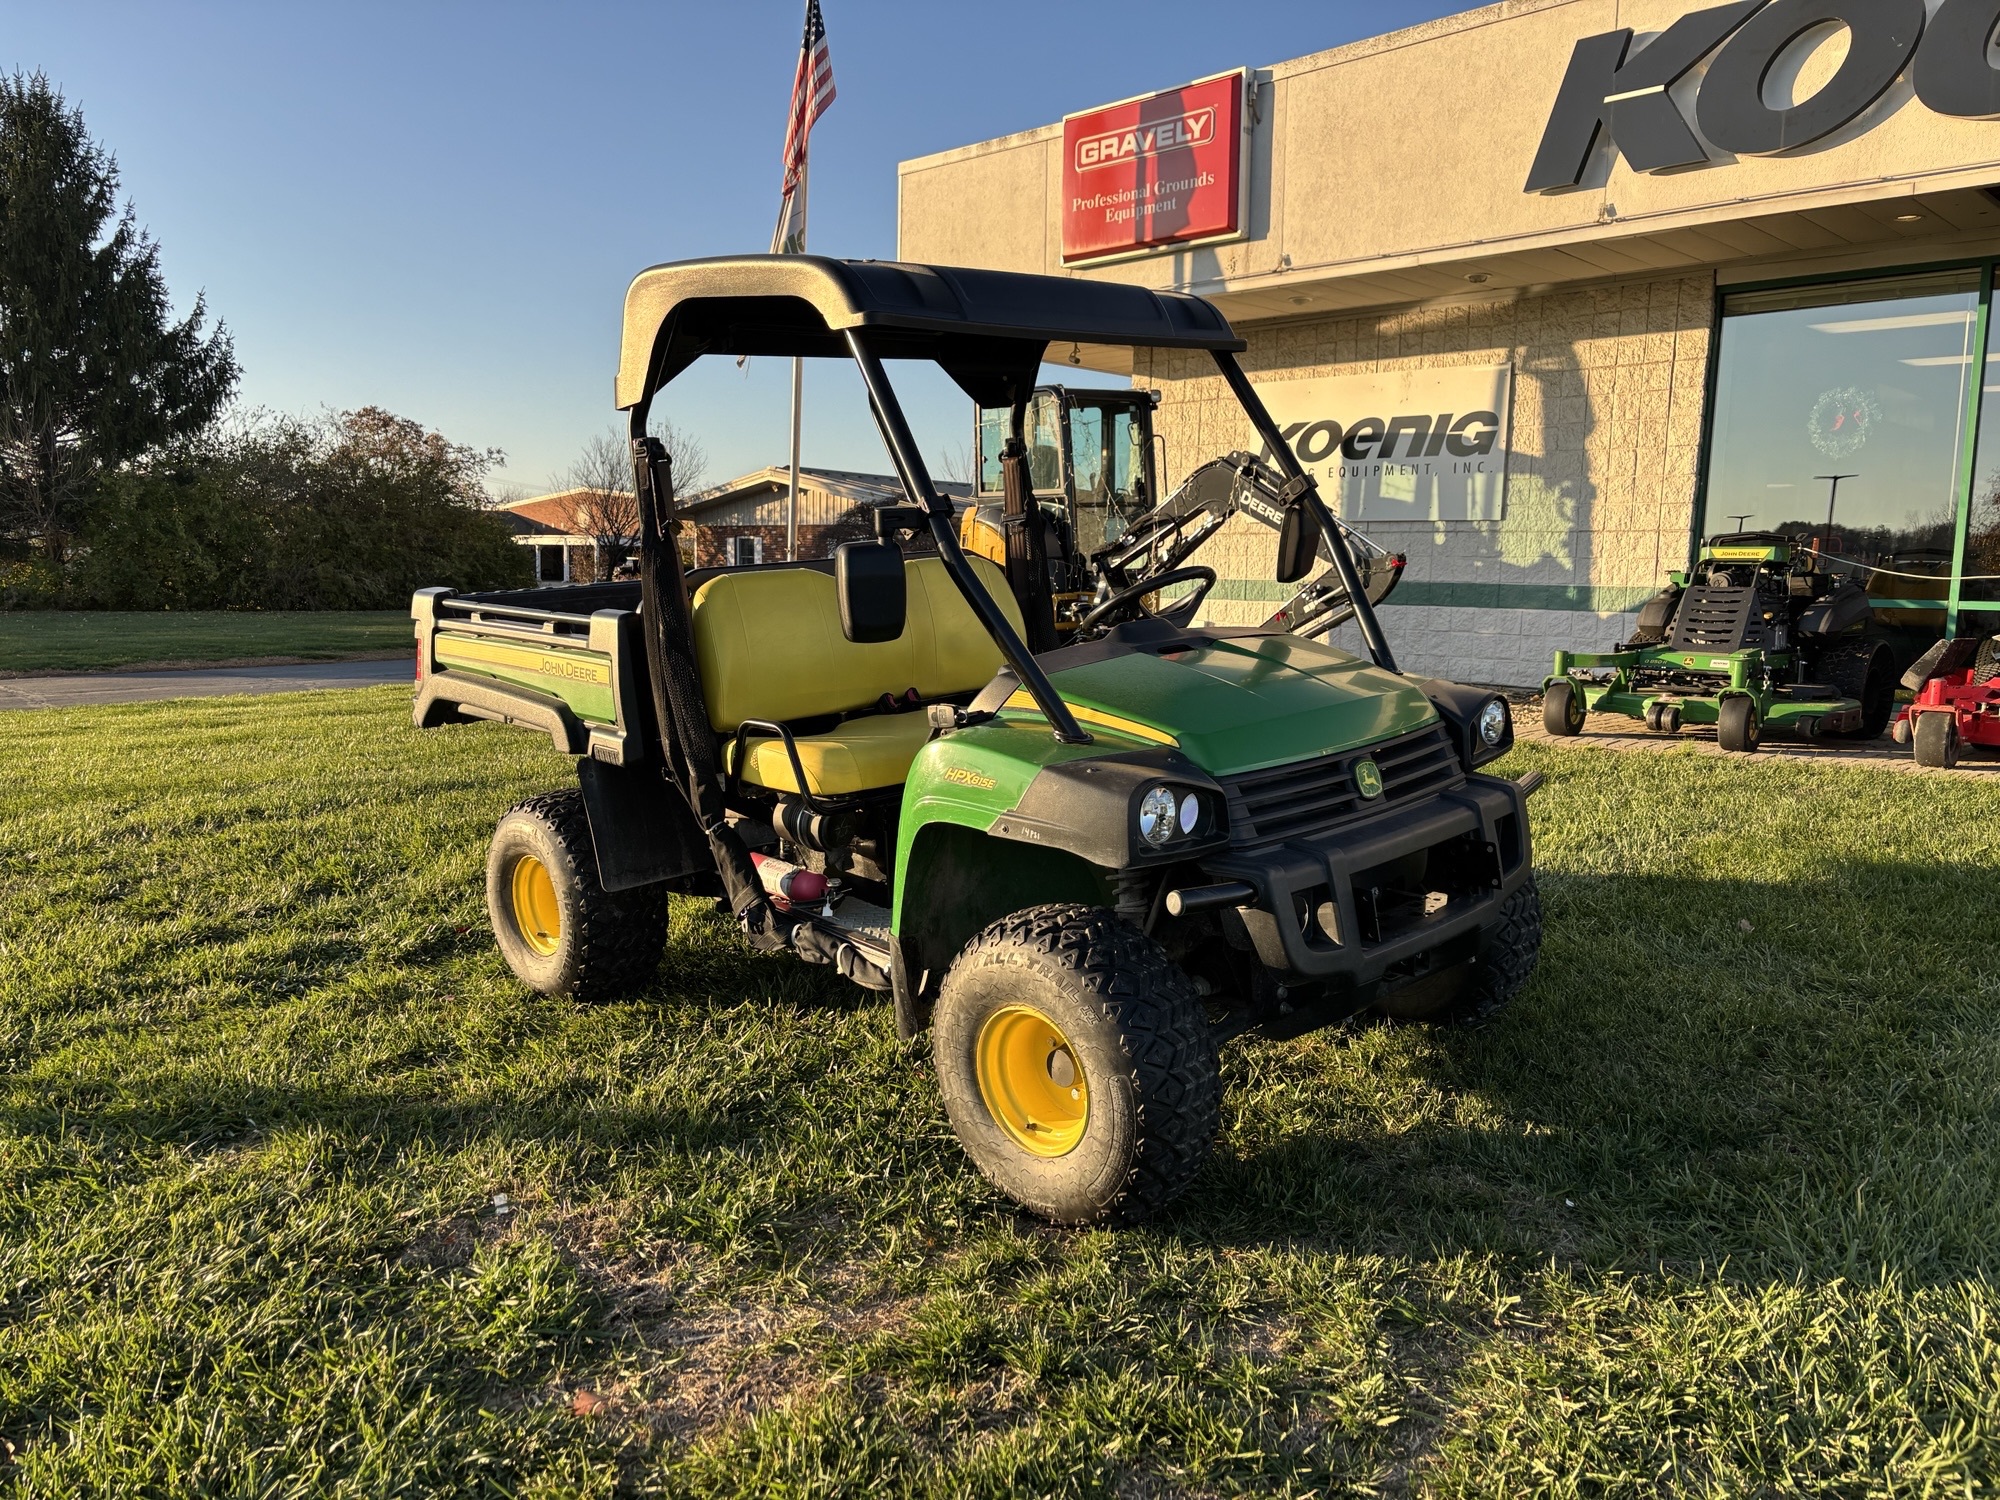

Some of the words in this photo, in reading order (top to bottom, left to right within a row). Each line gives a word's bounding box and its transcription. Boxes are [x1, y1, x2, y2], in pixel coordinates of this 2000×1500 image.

[1080, 113, 1209, 165] GRAVELY
[1072, 183, 1150, 213] Professional
[1154, 171, 1215, 196] Grounds
[1105, 197, 1177, 224] Equipment
[1328, 463, 1439, 479] EQUIPMENT,
[1453, 461, 1494, 474] INC.
[1240, 490, 1284, 524] DEERE
[540, 658, 565, 677] JOHN
[566, 662, 598, 682] DEERE
[983, 953, 1018, 967] ALL
[1027, 957, 1080, 1004] TRAIL
